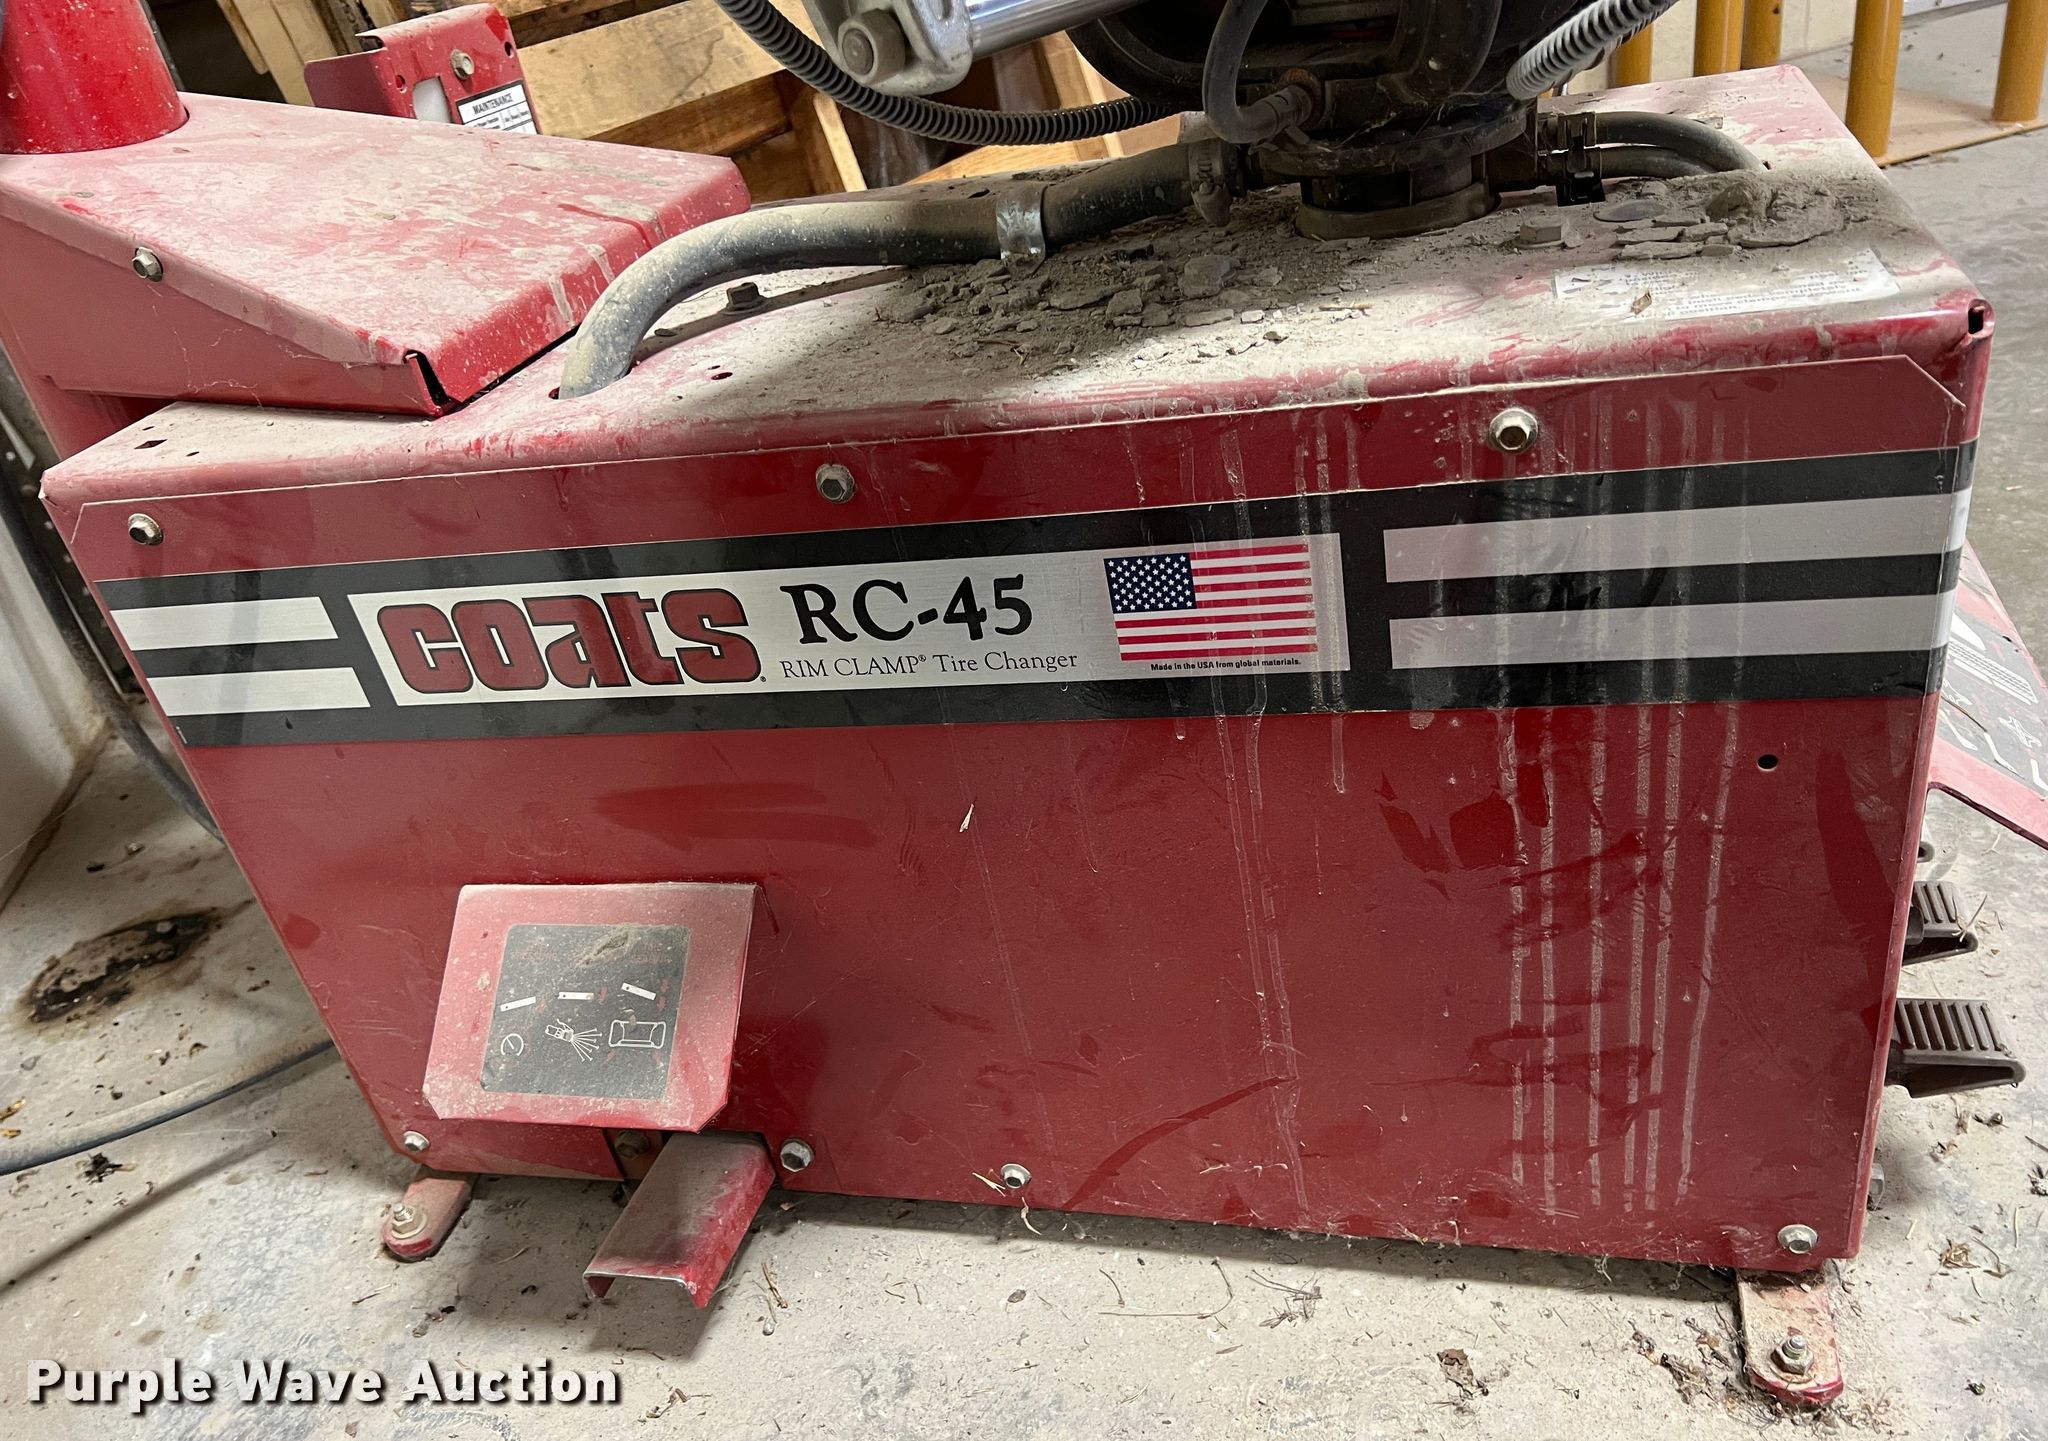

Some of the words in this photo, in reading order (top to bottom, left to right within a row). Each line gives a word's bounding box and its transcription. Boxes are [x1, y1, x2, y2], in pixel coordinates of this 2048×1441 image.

[472, 93, 514, 115] MAINTENANCE
[780, 574, 1033, 644] RC-45
[780, 659, 828, 679] RIM
[933, 653, 979, 673] Tire
[984, 651, 1078, 673] Changer
[1151, 663, 1173, 671] Made
[1183, 662, 1196, 670] the
[1197, 660, 1215, 669] USA
[1216, 660, 1234, 669] from
[1235, 659, 1260, 669] global
[1261, 657, 1302, 667] materials.
